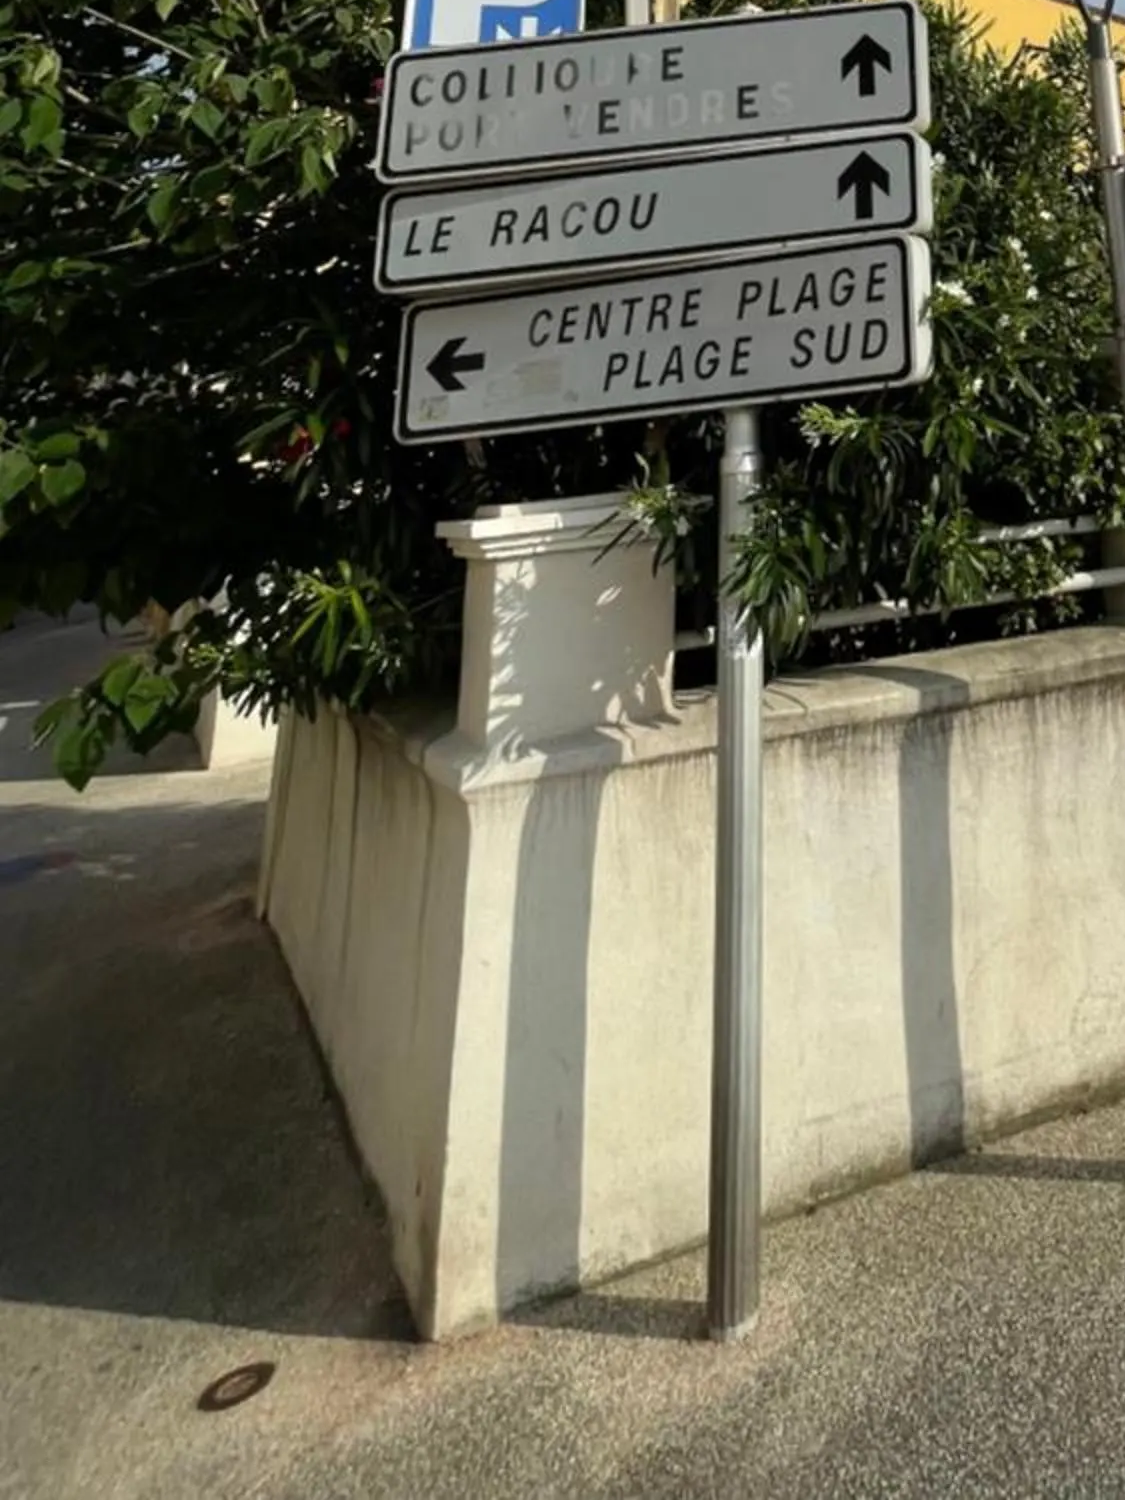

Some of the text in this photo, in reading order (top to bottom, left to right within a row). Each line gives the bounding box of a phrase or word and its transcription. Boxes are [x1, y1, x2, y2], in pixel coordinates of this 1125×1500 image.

[403, 192, 658, 258] LE RACOU
[528, 262, 888, 348] CENTRE PLAGE
[603, 318, 889, 393] PLAGE SUD
